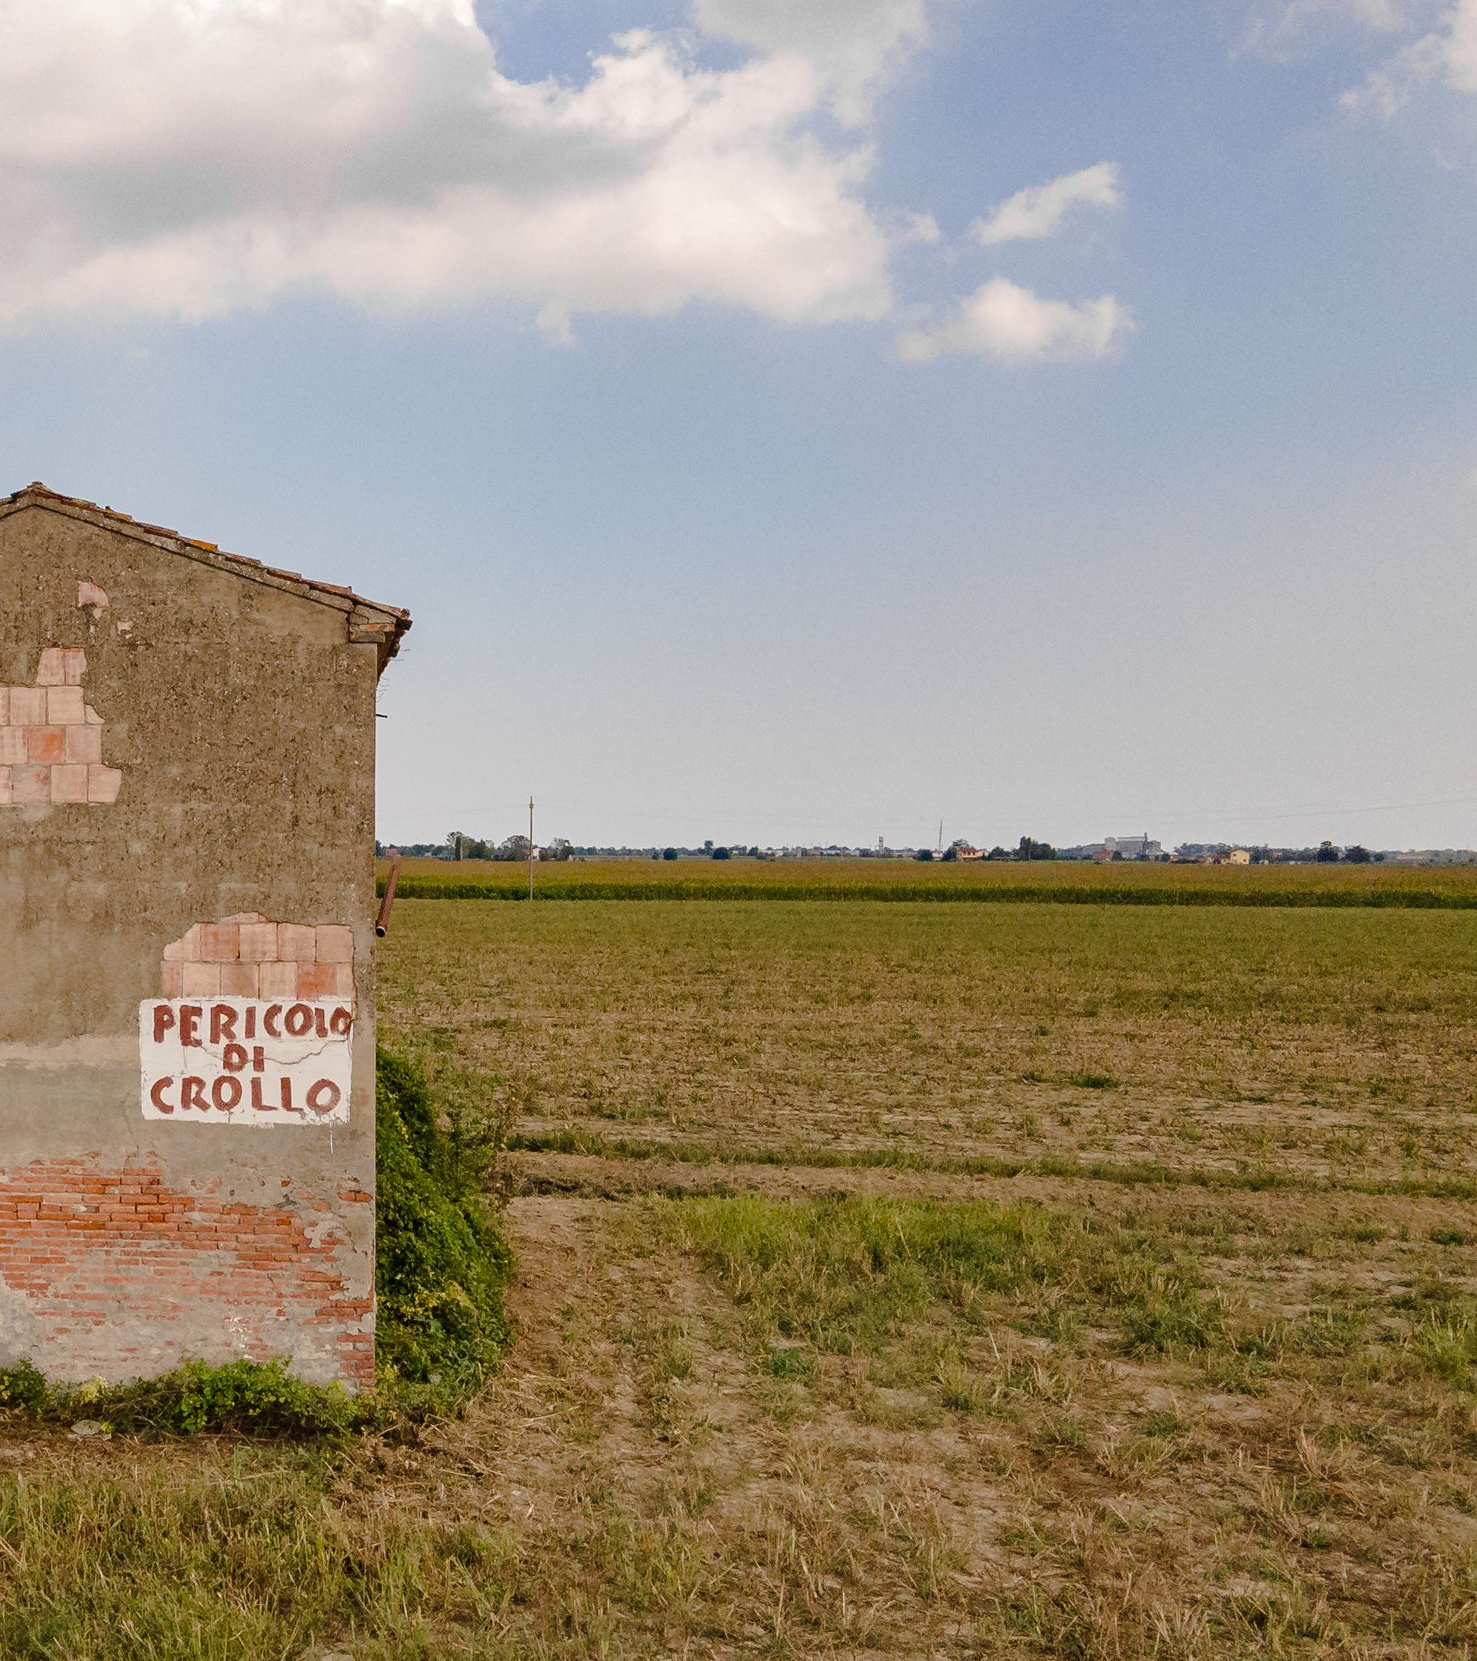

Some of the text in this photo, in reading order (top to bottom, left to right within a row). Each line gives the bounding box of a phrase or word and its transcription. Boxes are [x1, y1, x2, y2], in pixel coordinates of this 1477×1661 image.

[152, 1003, 353, 1048] PERICOLO
[222, 1043, 266, 1073] DI
[149, 1075, 342, 1115] CROLLO
